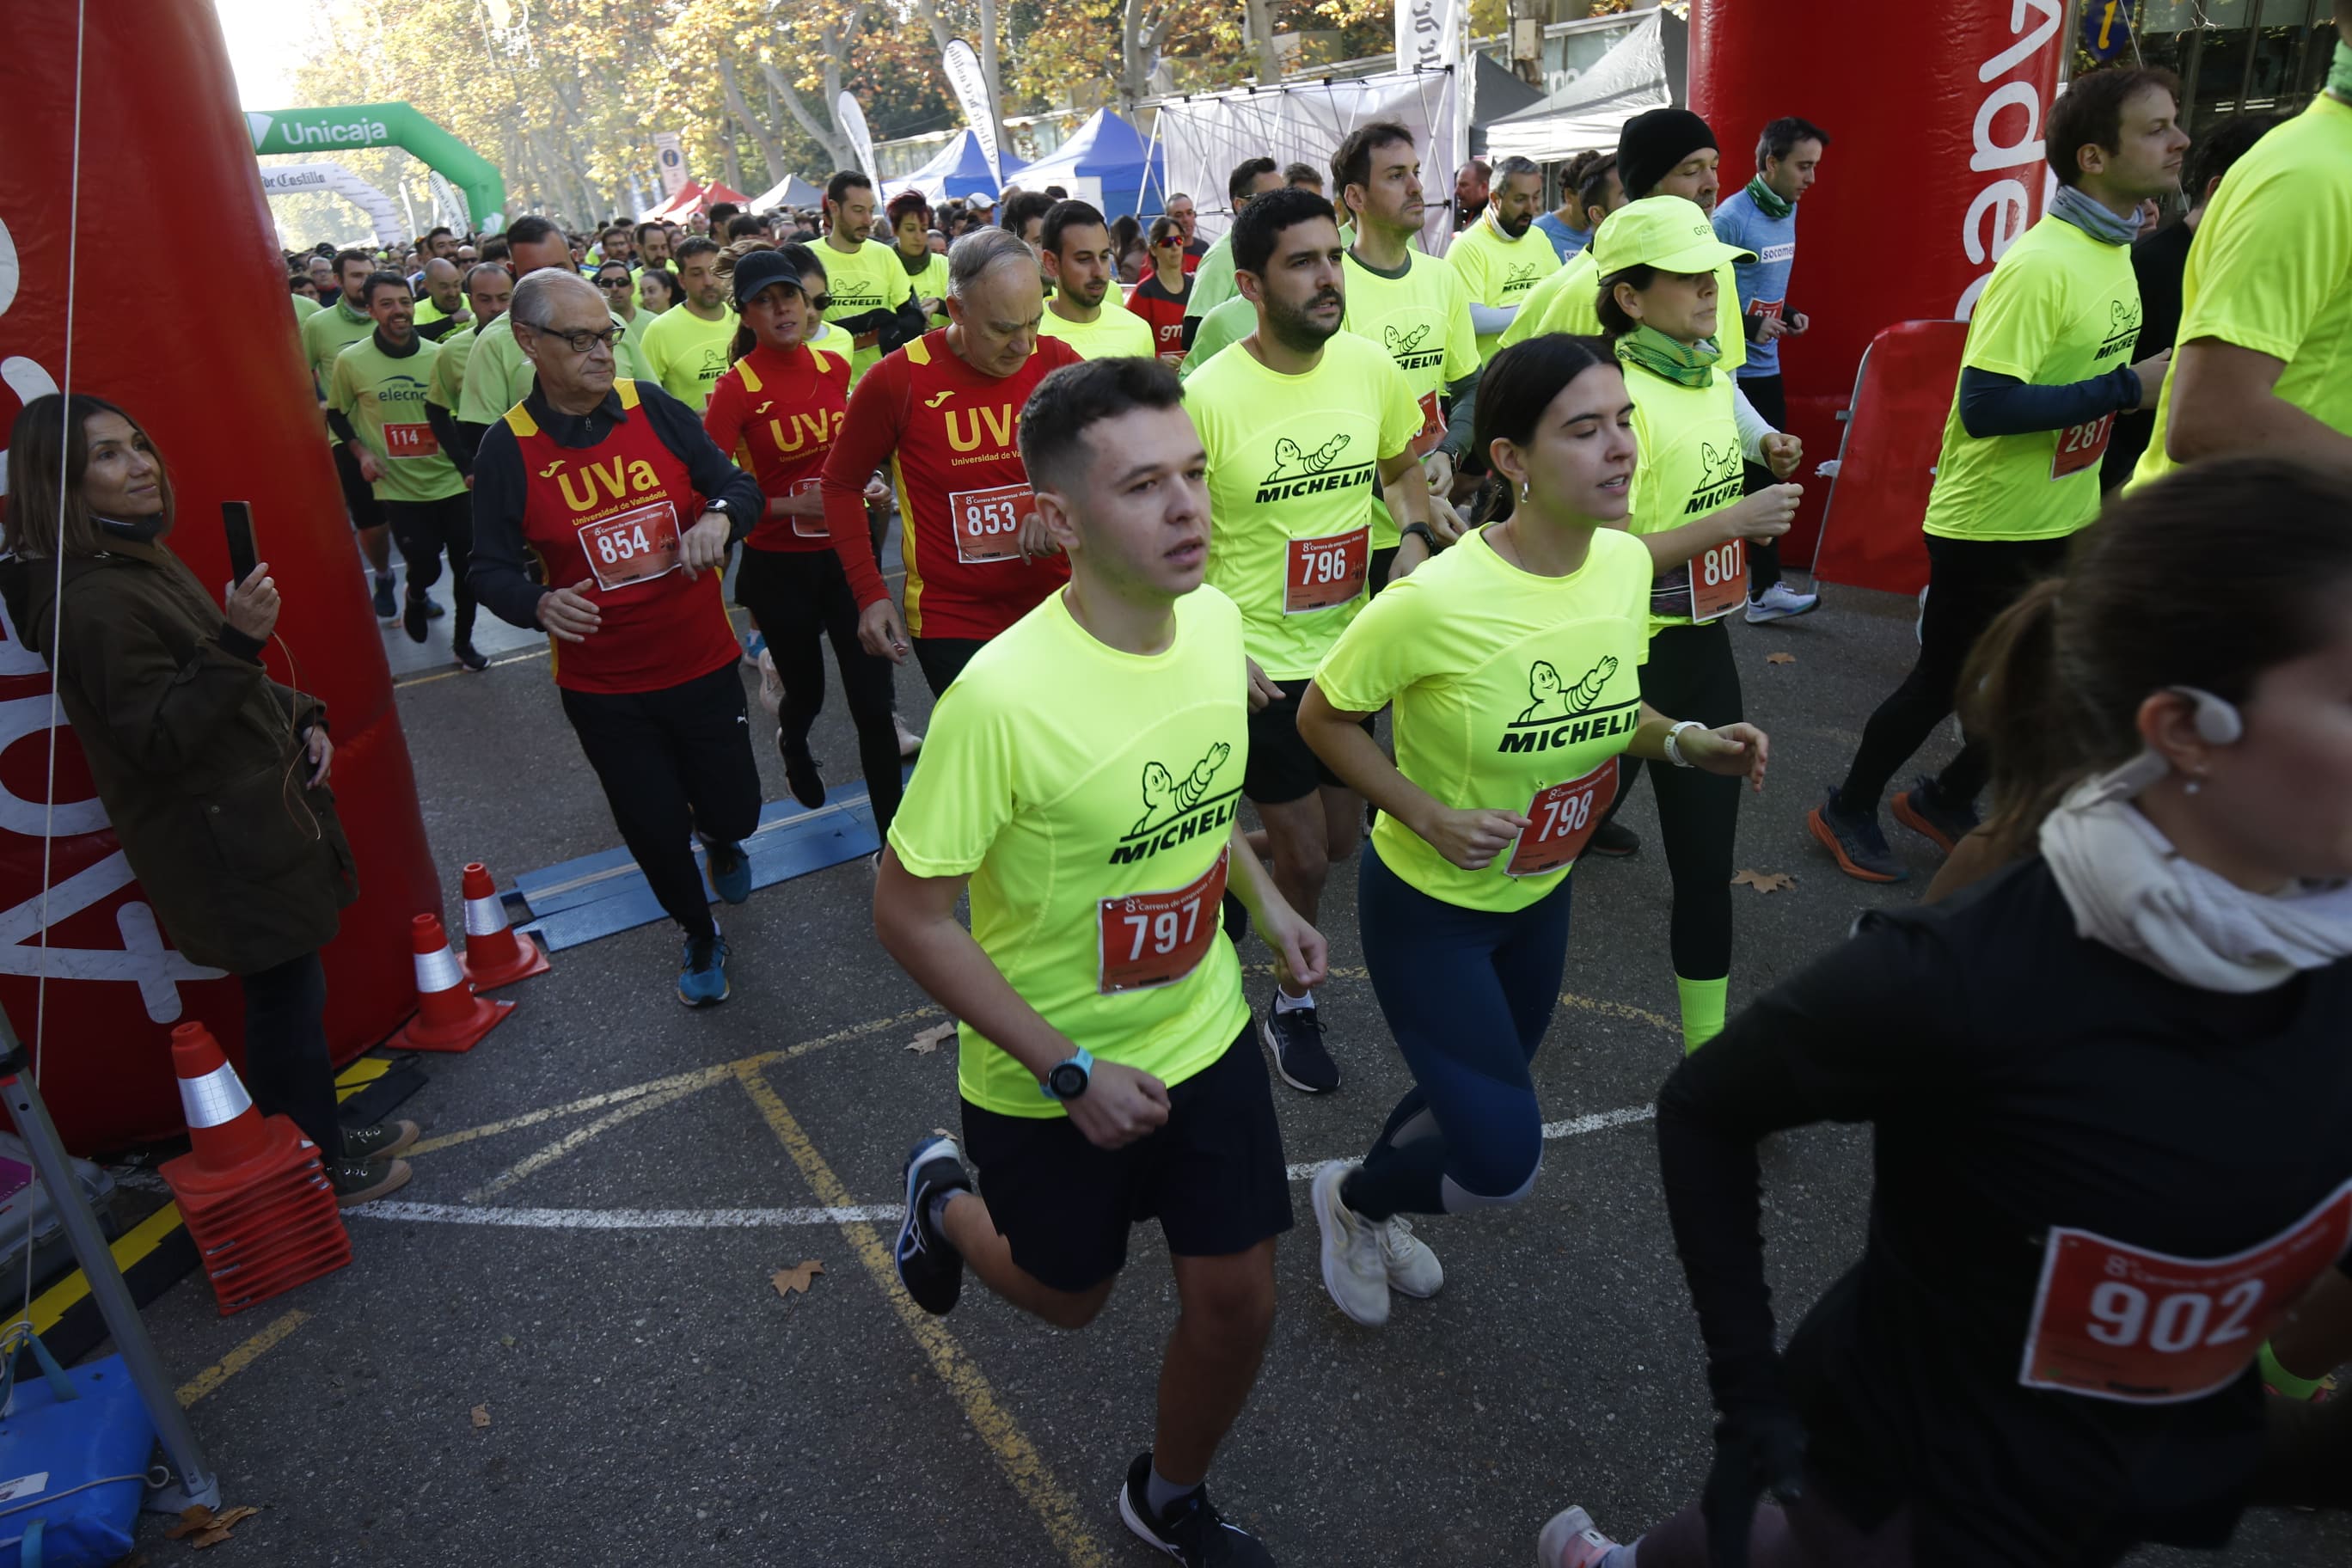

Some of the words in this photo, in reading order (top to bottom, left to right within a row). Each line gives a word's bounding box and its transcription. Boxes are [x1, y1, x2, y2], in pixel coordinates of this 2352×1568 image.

[281, 118, 388, 144] Unicaja
[277, 171, 326, 187] Castilla
[1160, 324, 1183, 342] gm
[379, 388, 426, 401] elecno
[391, 430, 420, 445] 114
[945, 404, 1021, 451] UV
[2065, 414, 2108, 452] 287
[952, 453, 999, 466] Universidad
[557, 455, 660, 511] UVa
[572, 505, 619, 526] Universidad
[966, 502, 1016, 536] 853
[597, 525, 650, 564] 854
[1704, 539, 1740, 586] 801
[1302, 548, 1345, 585] 796
[1109, 799, 1237, 864] MICHELI
[1539, 790, 1593, 842] 798
[1124, 898, 1201, 961] 797
[2086, 1279, 2265, 1354] 902
